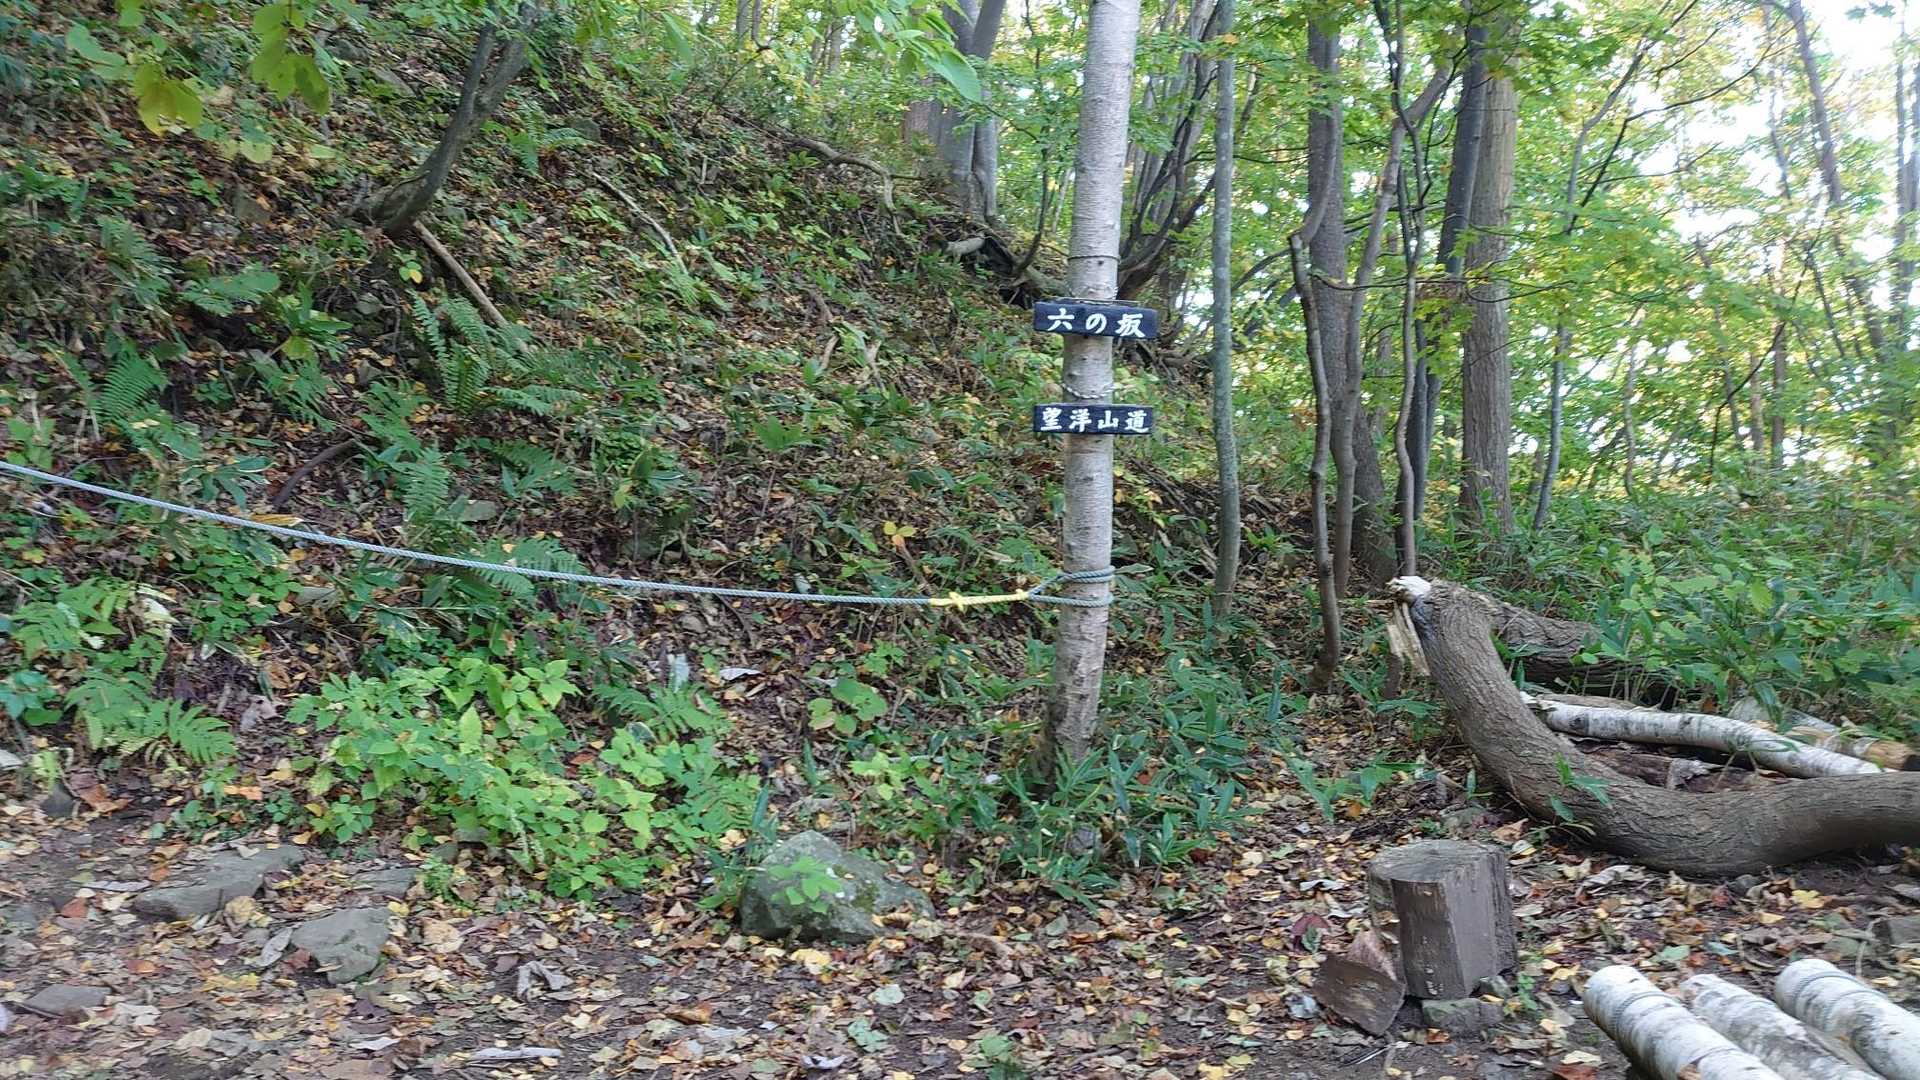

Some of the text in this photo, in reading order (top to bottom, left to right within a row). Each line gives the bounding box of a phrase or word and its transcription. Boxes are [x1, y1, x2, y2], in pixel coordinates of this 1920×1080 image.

[1047, 307, 1146, 338] 六の坂
[1040, 407, 1150, 433] 望洋山道
